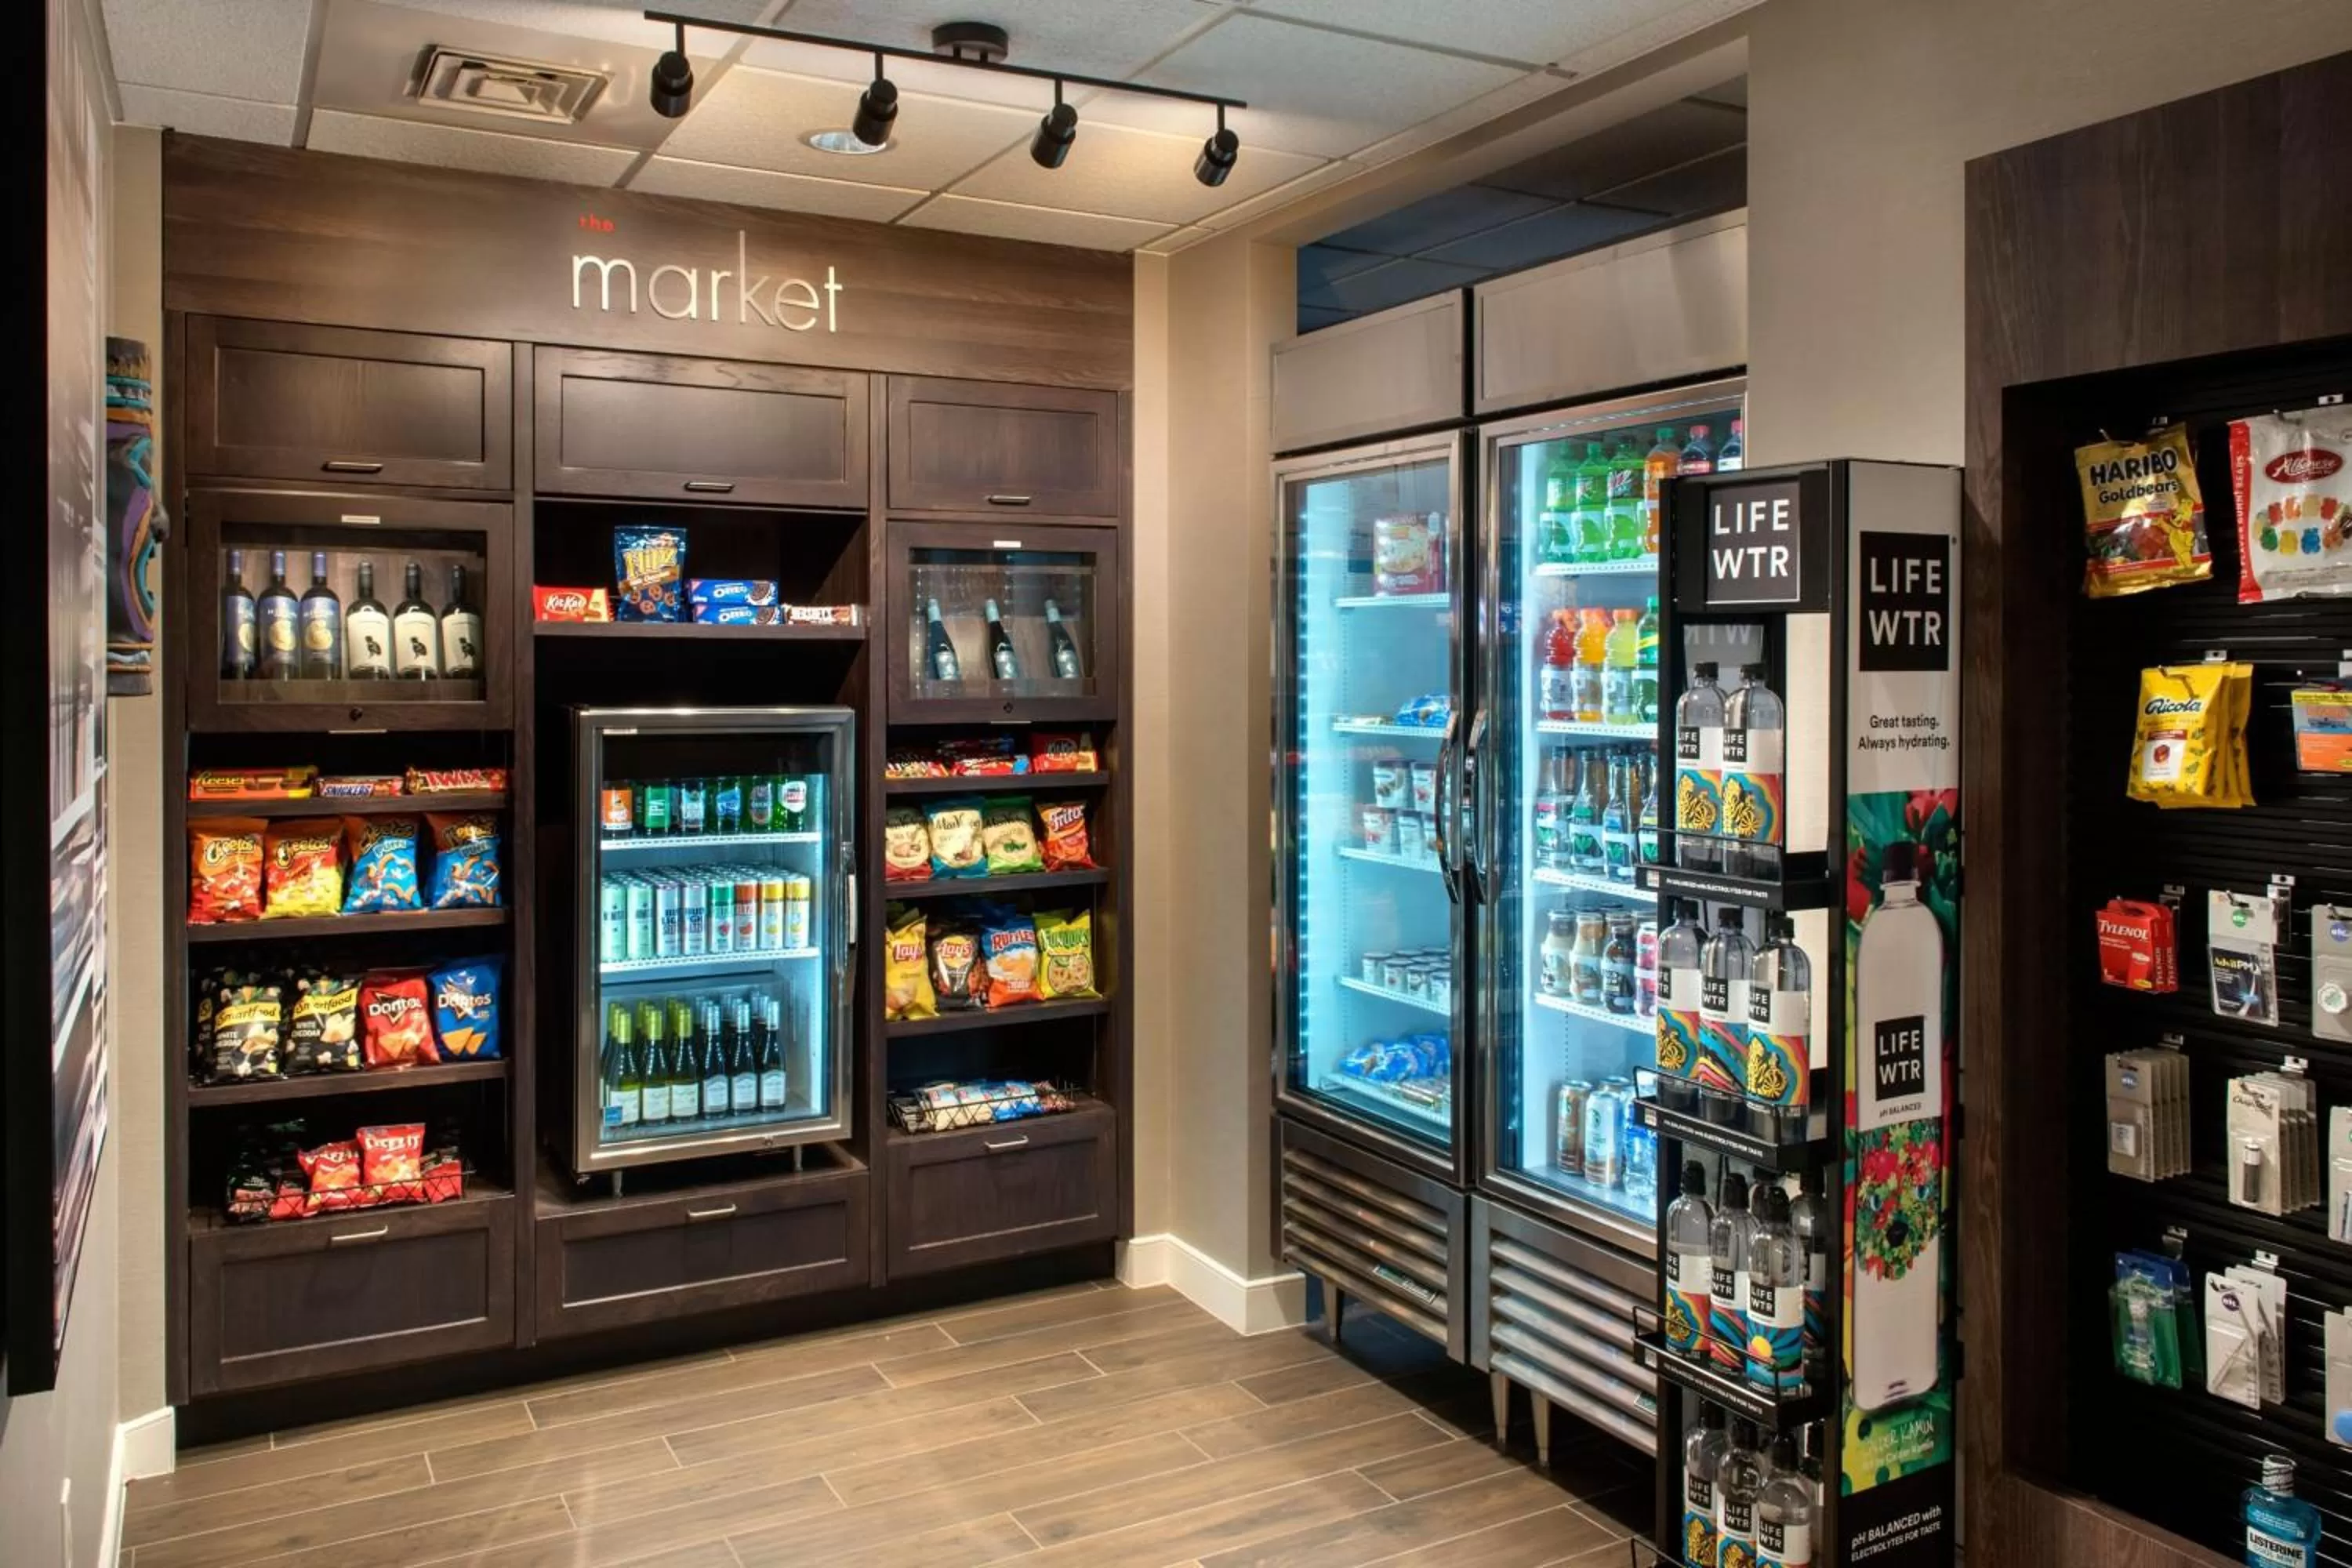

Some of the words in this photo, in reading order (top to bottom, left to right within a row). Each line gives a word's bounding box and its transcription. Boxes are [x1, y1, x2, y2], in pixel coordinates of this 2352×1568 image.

[572, 230, 844, 332] market
[2089, 448, 2179, 487] HARIBO
[2099, 478, 2180, 504] Goldbears
[1715, 499, 1790, 535] LIFE
[1712, 546, 1789, 579] WTR
[1871, 557, 1942, 594] LIFE
[1869, 610, 1942, 645] WTR
[2144, 695, 2201, 714] Ricola
[1870, 715, 1900, 728] Great
[1901, 713, 1940, 730] tasting.
[1858, 736, 1896, 752] Always
[1898, 735, 1951, 751] hydrating.
[2099, 919, 2149, 942] TYLENOL
[1879, 1029, 1920, 1056] LIFE
[1879, 1059, 1920, 1085] WTR
[1751, 1287, 1773, 1301] LIFE
[1751, 1300, 1773, 1313] WTR
[1690, 1479, 1710, 1494] LIFE
[1726, 1503, 1750, 1517] LIFE
[1726, 1514, 1750, 1529] WTR
[1851, 1531, 1867, 1550] pH
[1867, 1512, 1921, 1542] BALANCED
[1922, 1504, 1942, 1522] with
[1904, 1529, 1919, 1543] FOR
[1919, 1519, 1941, 1537] TASTE
[2249, 1531, 2303, 1559] LISTERINE
